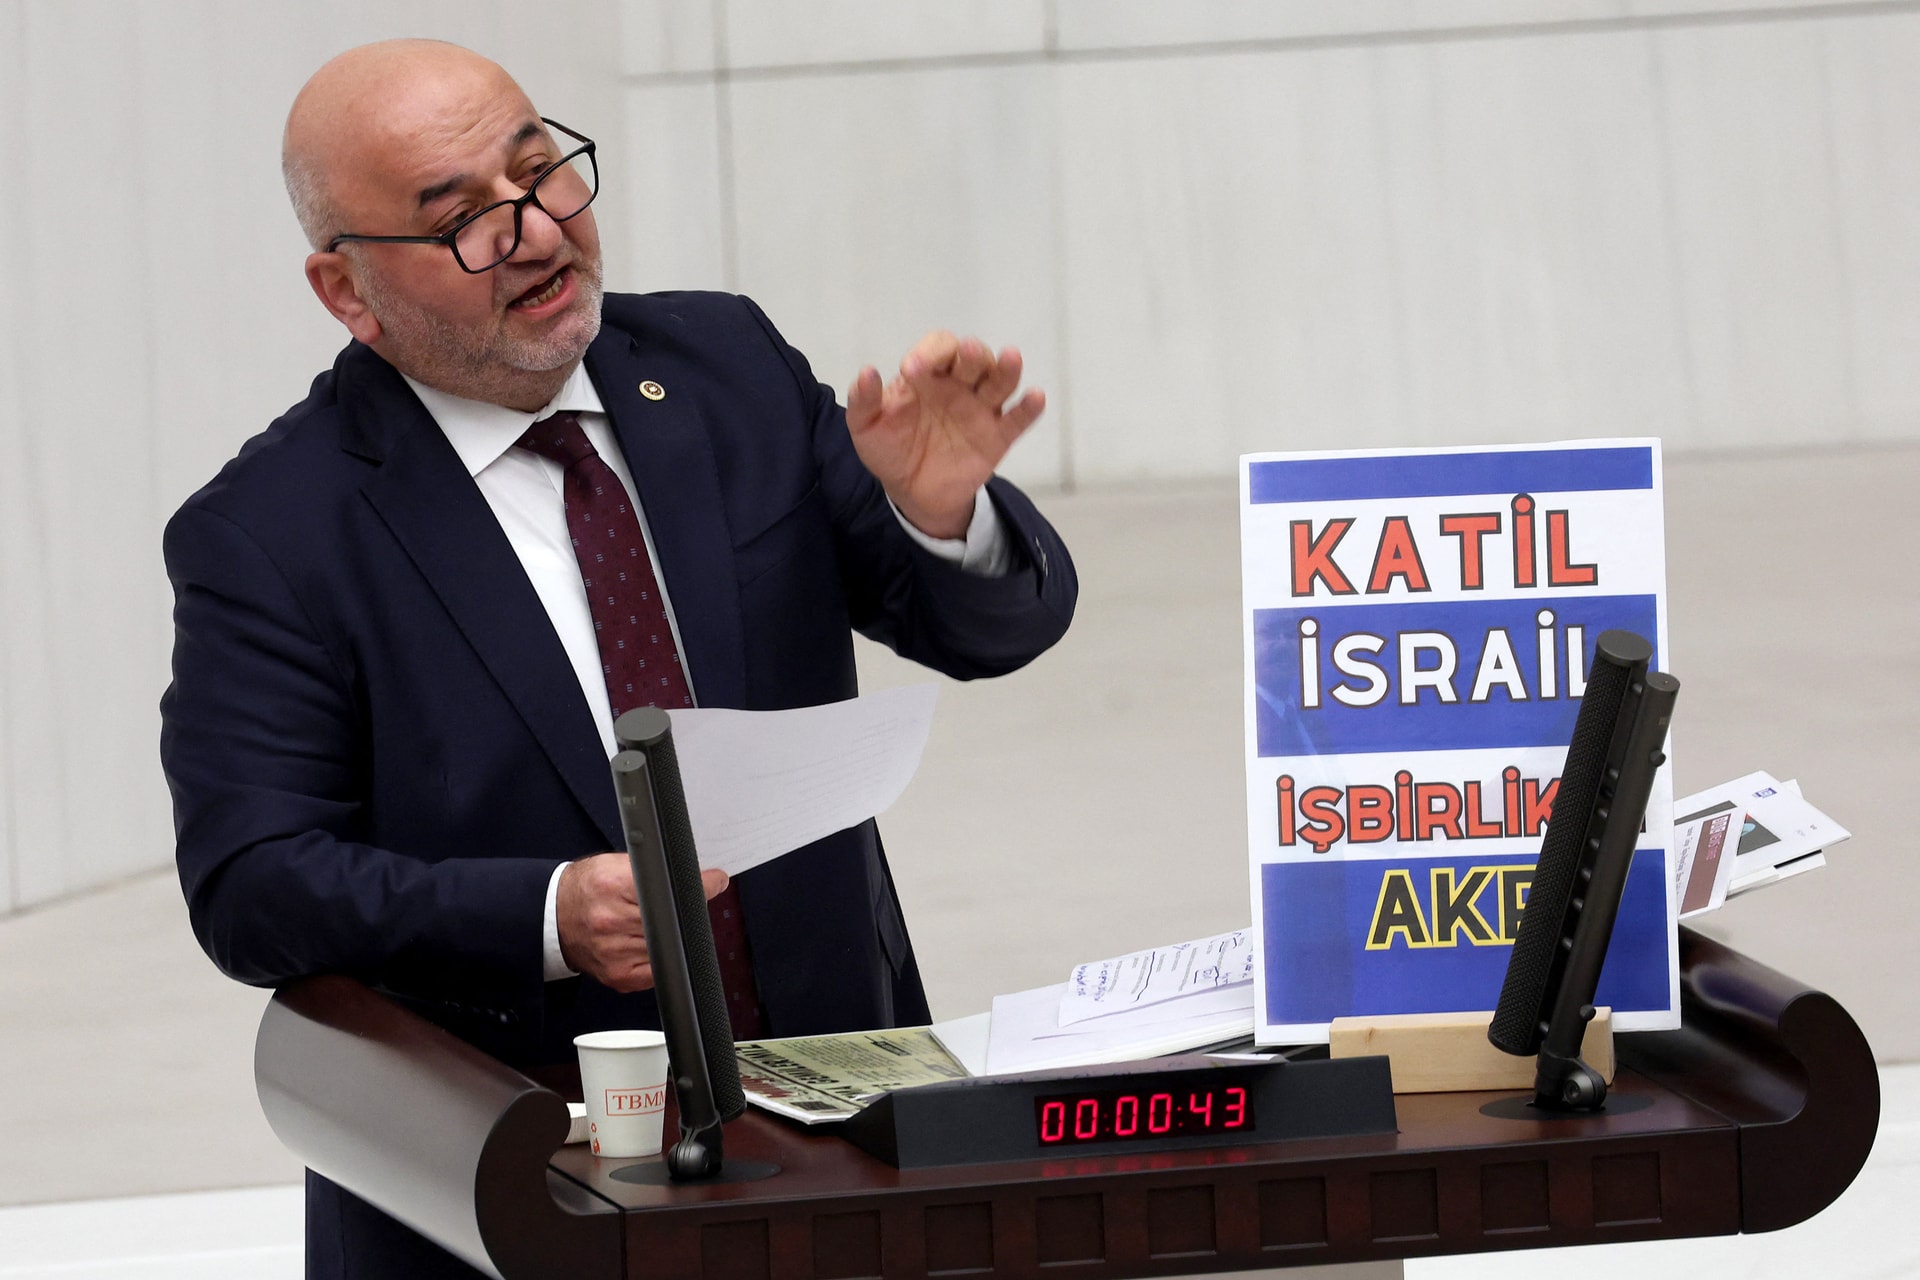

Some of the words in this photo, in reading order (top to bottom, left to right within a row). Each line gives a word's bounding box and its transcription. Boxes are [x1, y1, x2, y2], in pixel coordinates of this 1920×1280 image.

[1290, 493, 1598, 597] KATİL
[1298, 608, 1590, 710] İSRAİL
[1276, 765, 1646, 853] İŞBİRLİK
[1041, 1087, 1246, 1142] 00:00:43
